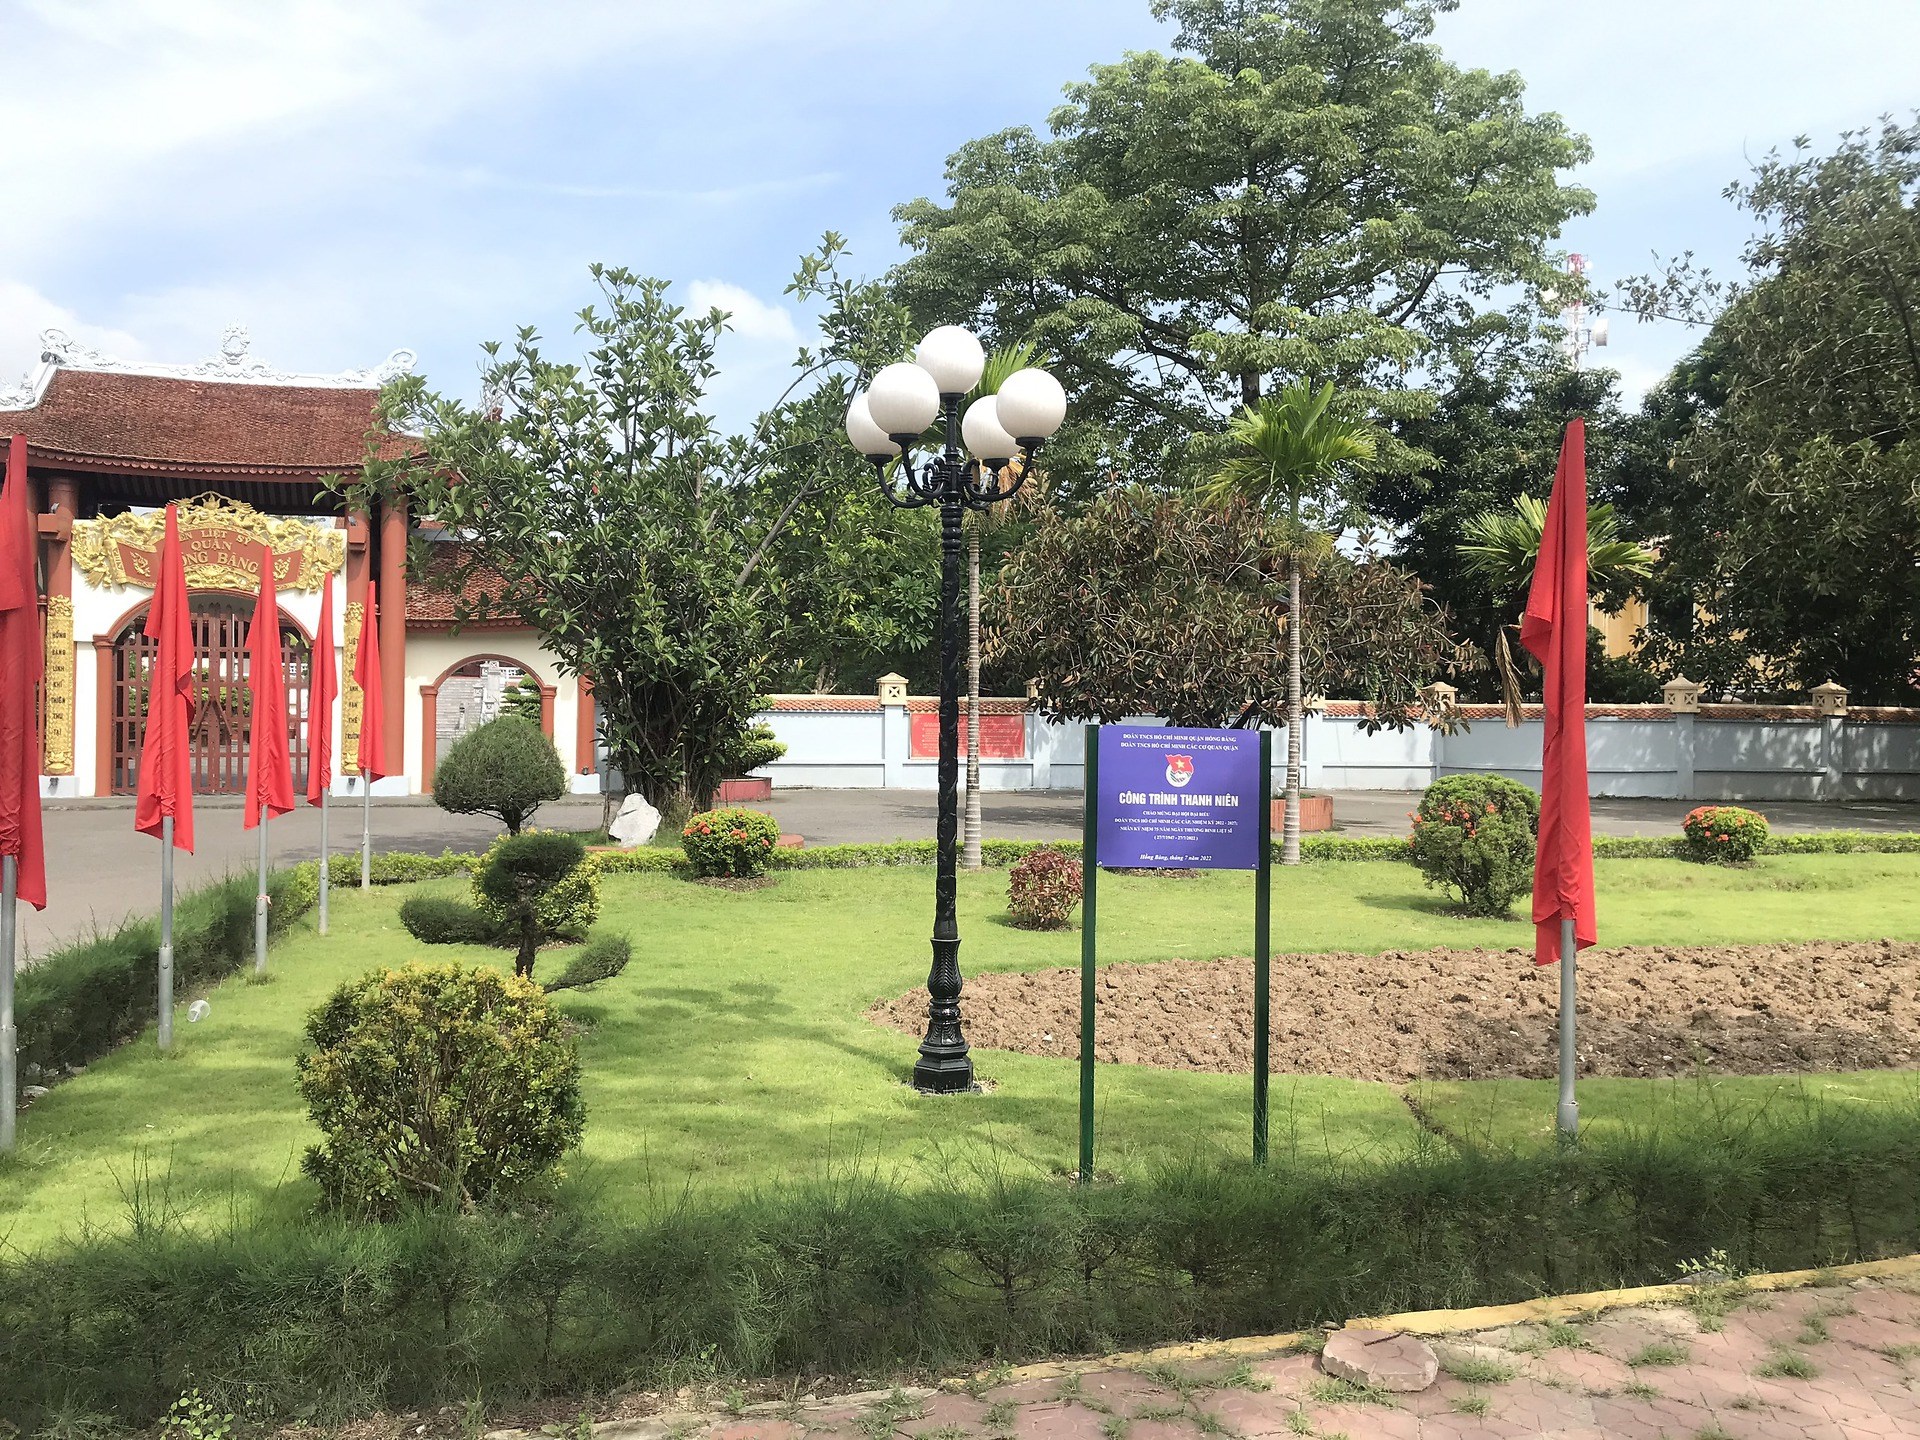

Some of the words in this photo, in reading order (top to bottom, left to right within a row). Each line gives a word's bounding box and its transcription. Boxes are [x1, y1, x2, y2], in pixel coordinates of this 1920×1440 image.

[201, 528, 227, 538] LIỆT
[191, 539, 232, 551] QUẬN
[217, 552, 259, 573] BÀNG
[1119, 790, 1146, 804] CÔNG
[1149, 792, 1177, 805] TRÌNH
[1180, 794, 1212, 806] THANH
[1215, 793, 1238, 807] NIÊN
